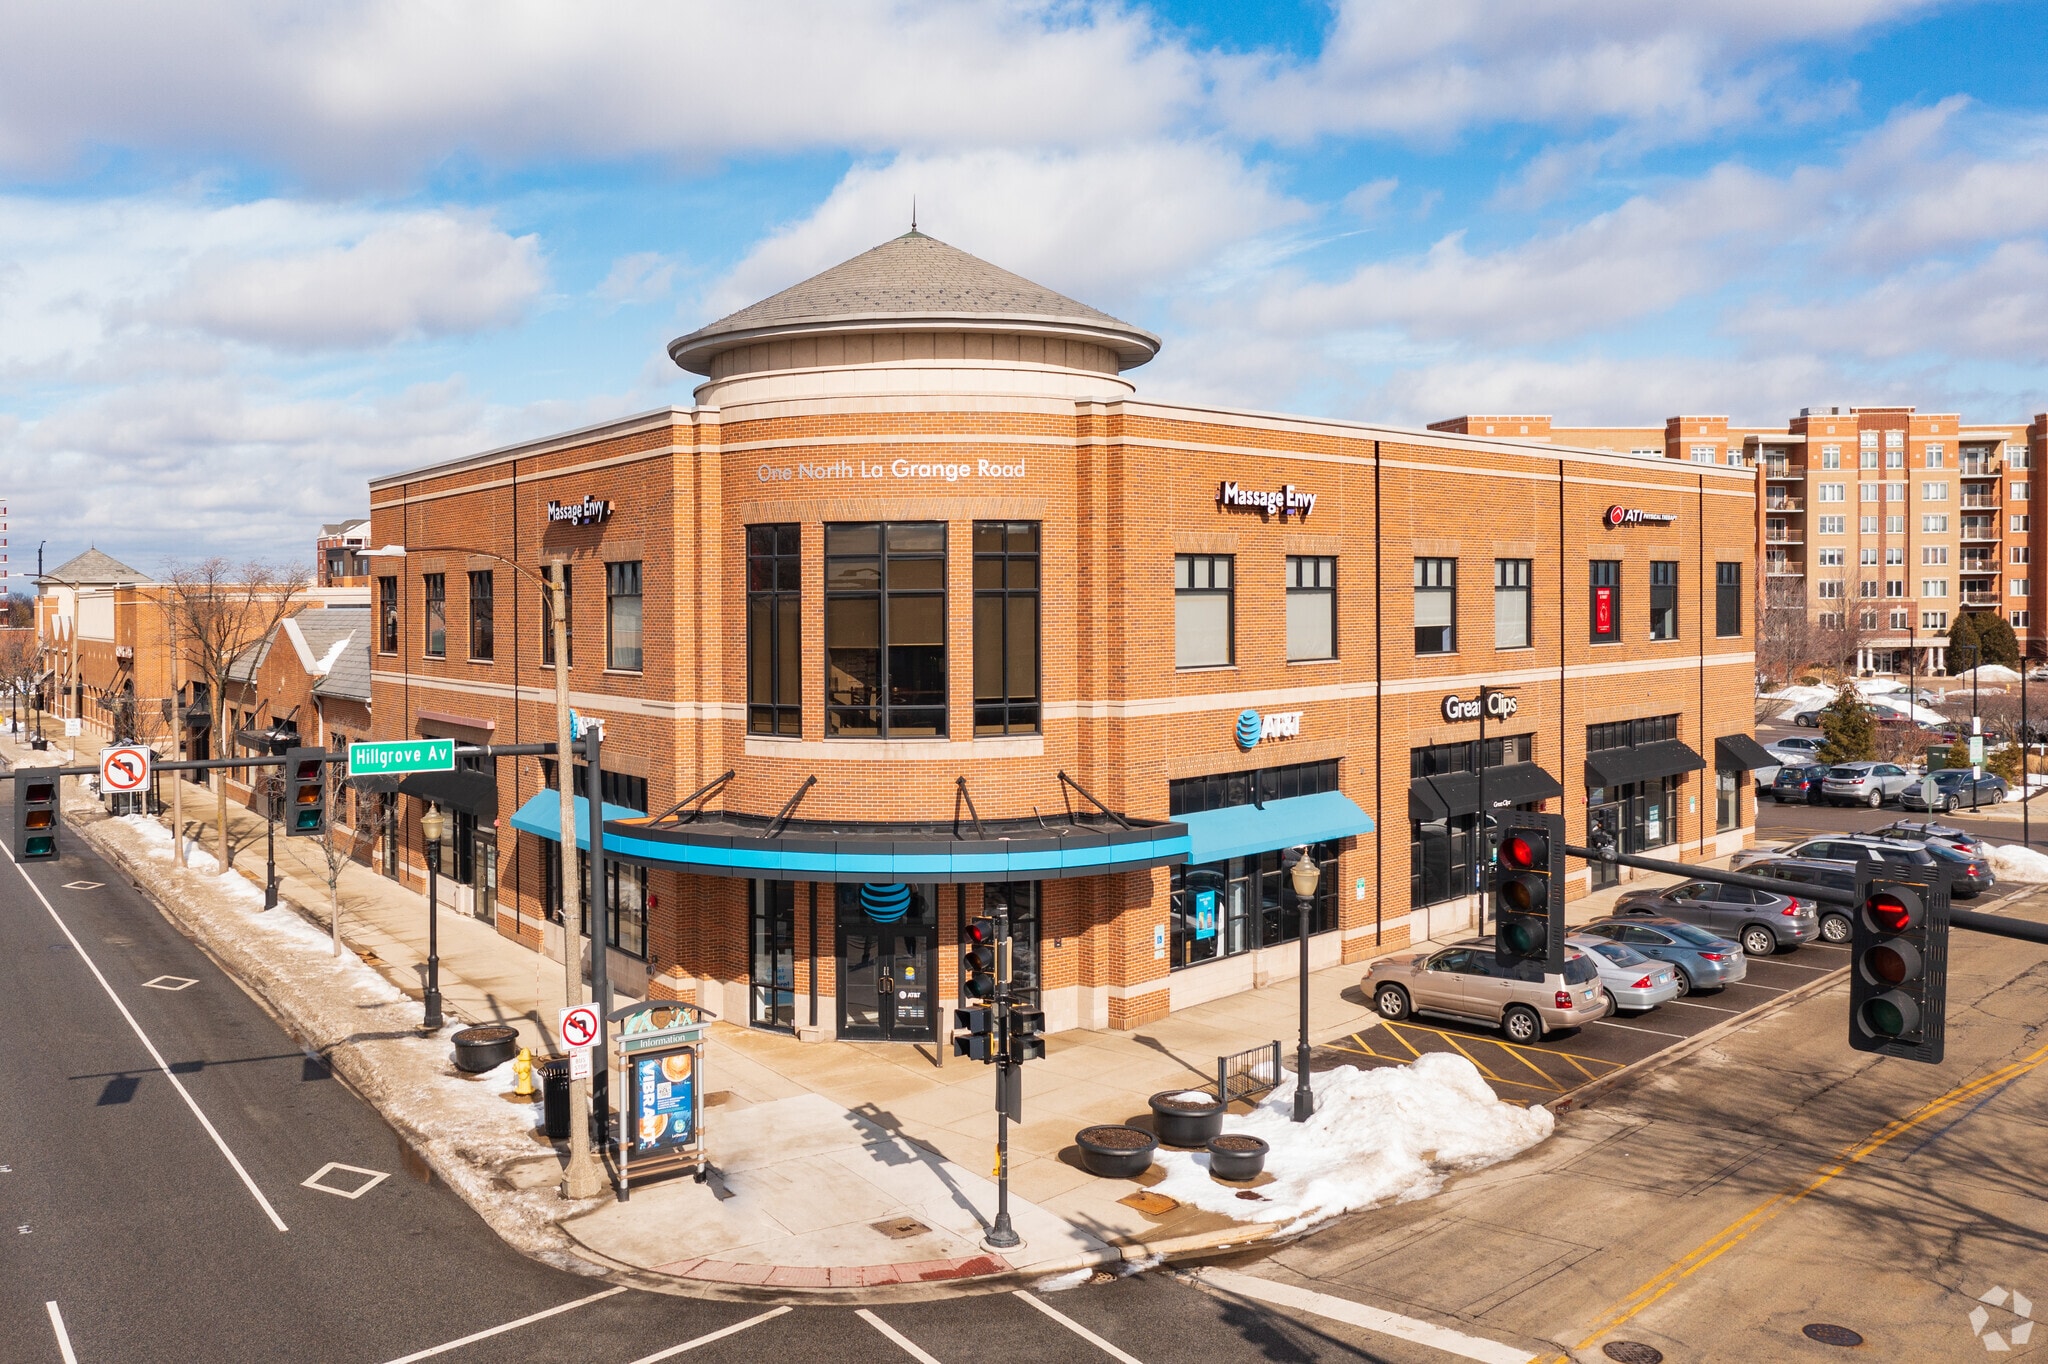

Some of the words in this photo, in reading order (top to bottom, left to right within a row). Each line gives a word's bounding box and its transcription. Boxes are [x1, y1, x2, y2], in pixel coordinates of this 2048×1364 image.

[757, 463, 793, 483] One
[799, 460, 853, 481] North
[861, 460, 883, 479] La
[891, 459, 971, 482] Grange
[978, 459, 1026, 478] Road
[547, 500, 582, 526] Massage
[583, 495, 604, 523] Envy
[1224, 481, 1284, 514] Massage
[1286, 484, 1318, 515] Envy
[1625, 509, 1643, 522] ATI
[1487, 692, 1518, 719] Clips
[1260, 711, 1304, 739] AT&T
[356, 748, 421, 768] Hillgrove
[428, 745, 447, 761] Av
[640, 1034, 686, 1048] Information
[642, 1061, 656, 1145] VIBRANT
